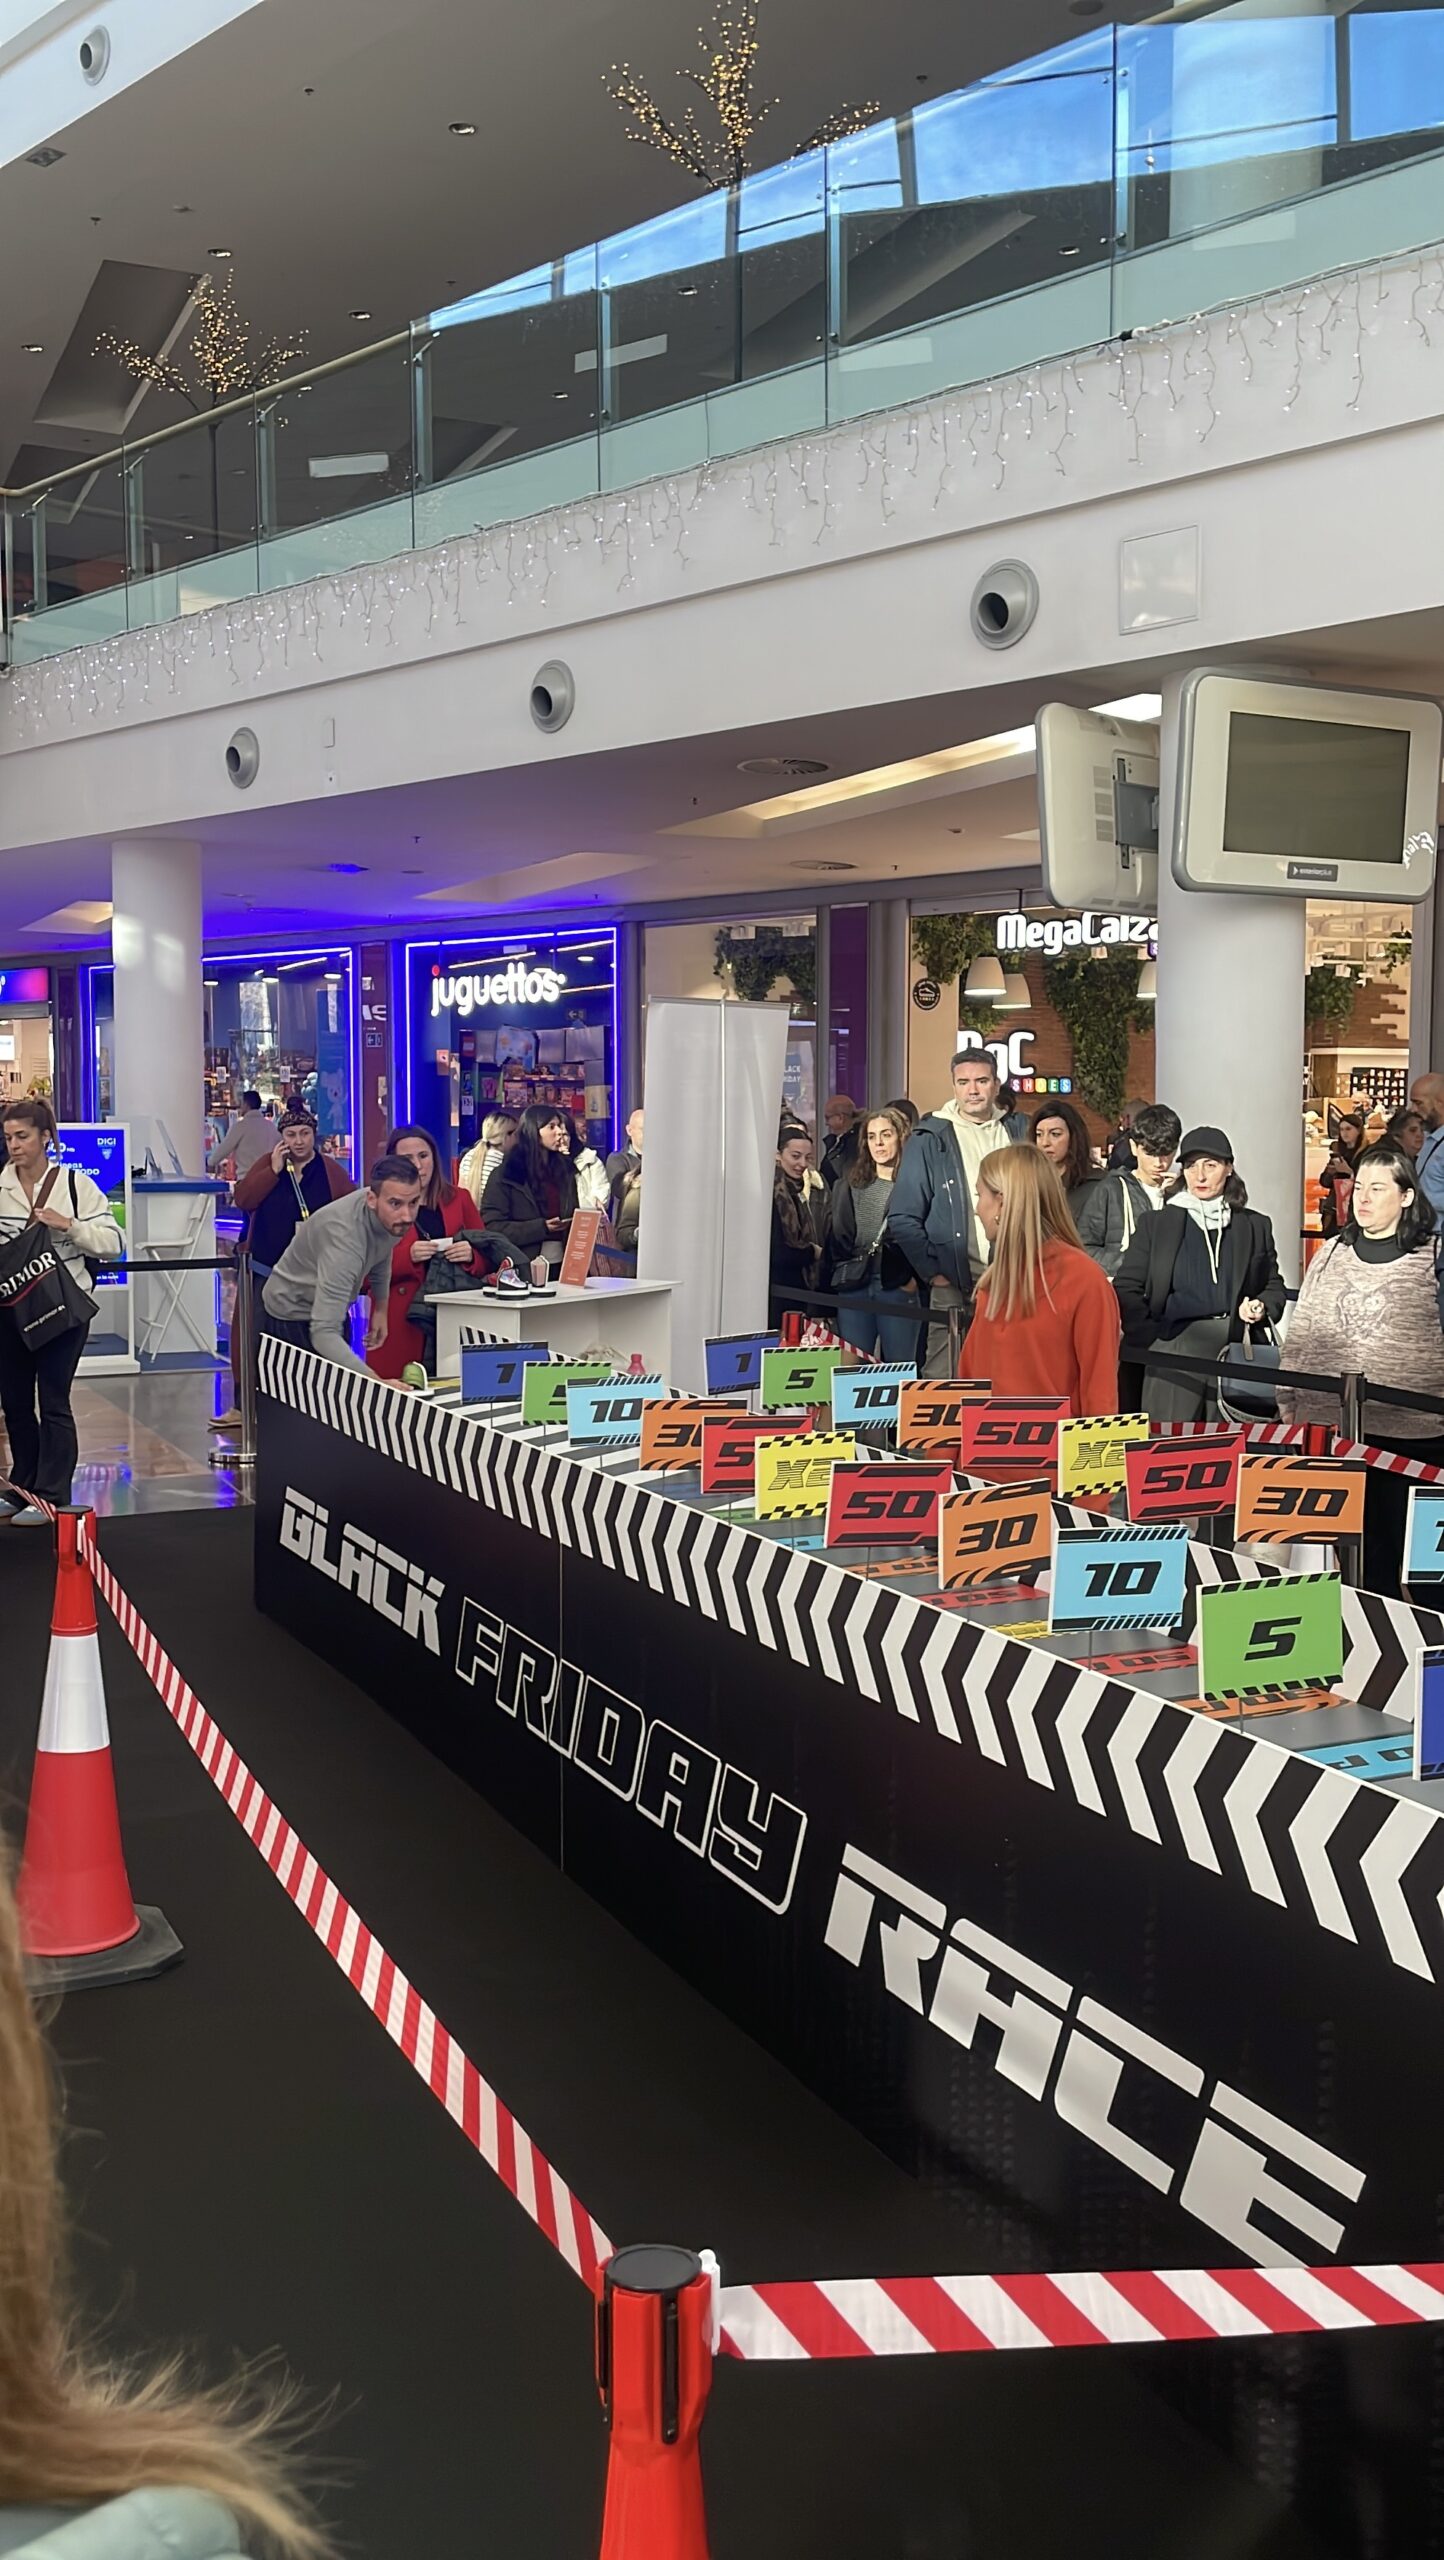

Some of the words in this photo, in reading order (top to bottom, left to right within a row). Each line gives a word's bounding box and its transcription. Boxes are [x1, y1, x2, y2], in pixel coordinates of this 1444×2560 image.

[431, 961, 560, 1017] juguettos
[1011, 1077, 1072, 1094] SHOES
[96, 1137, 116, 1146] DIGI
[785, 1368, 819, 1390] 5
[590, 1398, 643, 1423] 10
[852, 1384, 899, 1408] 10
[972, 1421, 1057, 1445] 50
[1140, 1460, 1233, 1495] 50
[841, 1490, 934, 1519] 50
[1252, 1486, 1349, 1516] 30
[955, 1513, 1039, 1557] 30
[1084, 1560, 1162, 1598] 10
[1244, 1616, 1303, 1662] 5
[279, 1485, 445, 1657] BLACK
[455, 1596, 808, 1916] FRIDAY
[823, 1842, 1368, 2269] RACE
